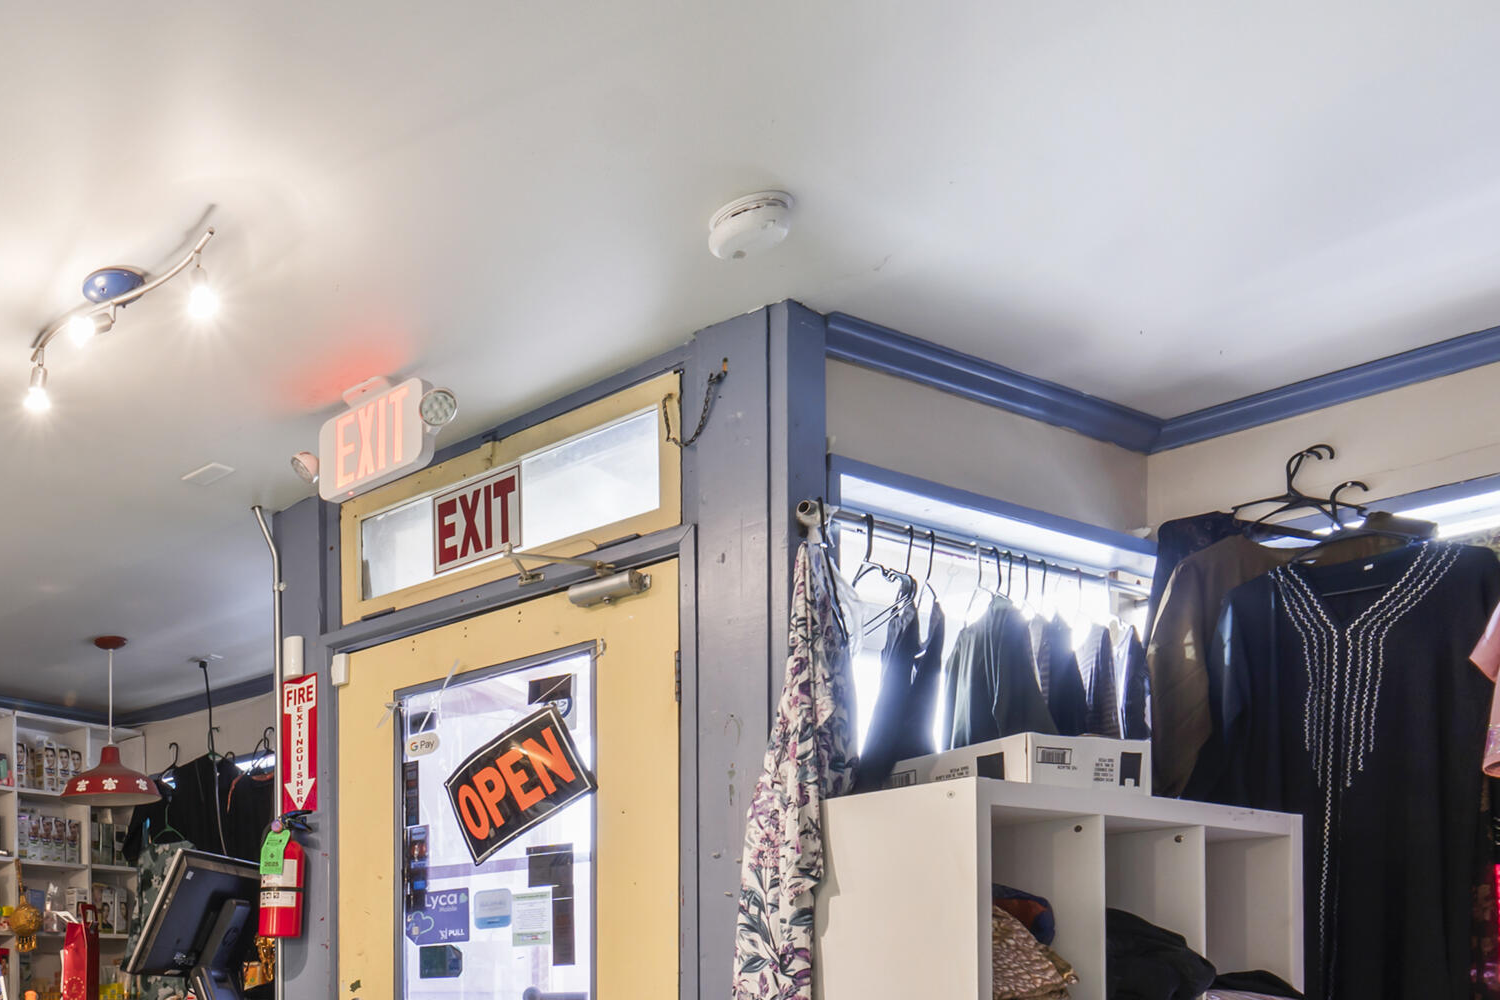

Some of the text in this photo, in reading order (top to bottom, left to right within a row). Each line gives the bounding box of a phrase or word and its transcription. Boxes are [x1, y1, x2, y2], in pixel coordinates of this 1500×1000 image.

[336, 386, 409, 489] EXIT
[438, 475, 515, 566] EXIT
[286, 684, 313, 707] FIRE
[296, 705, 304, 804] EXTINGUISHER
[420, 740, 435, 750] Pay
[458, 727, 576, 840] OPEN
[424, 893, 457, 909] Lyca
[448, 928, 465, 937] PULL
